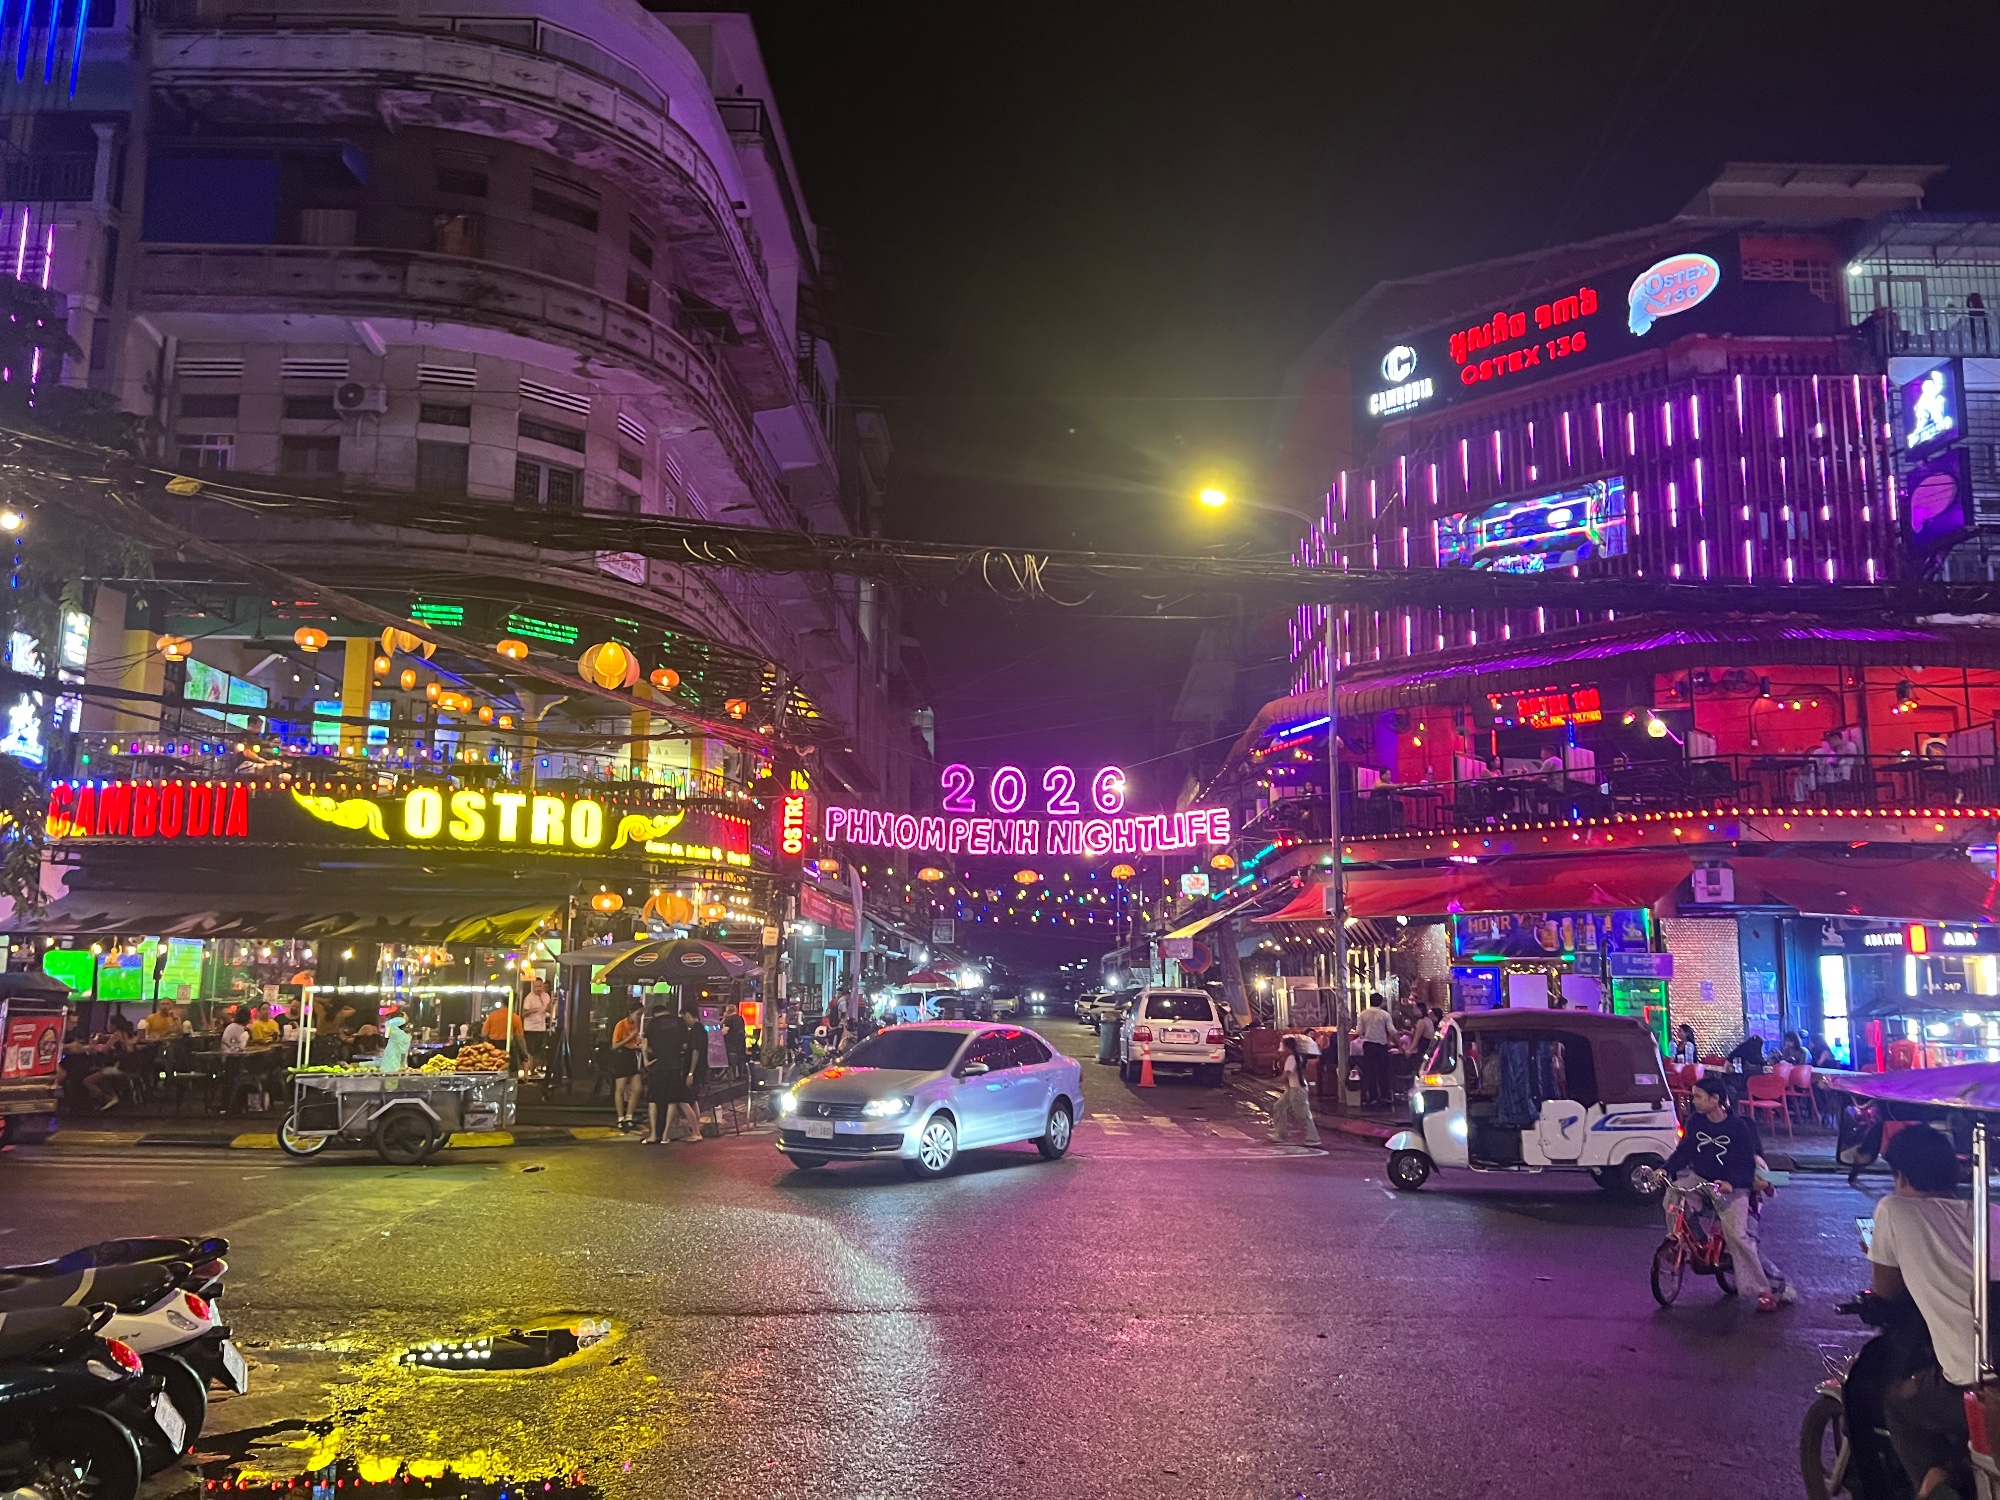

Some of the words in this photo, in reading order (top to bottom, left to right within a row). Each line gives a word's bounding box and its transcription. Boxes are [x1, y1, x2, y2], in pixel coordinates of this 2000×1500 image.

[1645, 265, 1709, 295] OSTEX
[1664, 284, 1699, 306] 136
[1460, 345, 1541, 386] OSTEX
[1546, 331, 1588, 360] 136
[1369, 377, 1434, 415] CAMBODIA
[45, 782, 248, 839] CAMBODIA
[404, 787, 603, 849] OSTRO
[1047, 808, 1230, 855] NIGHTLIFE
